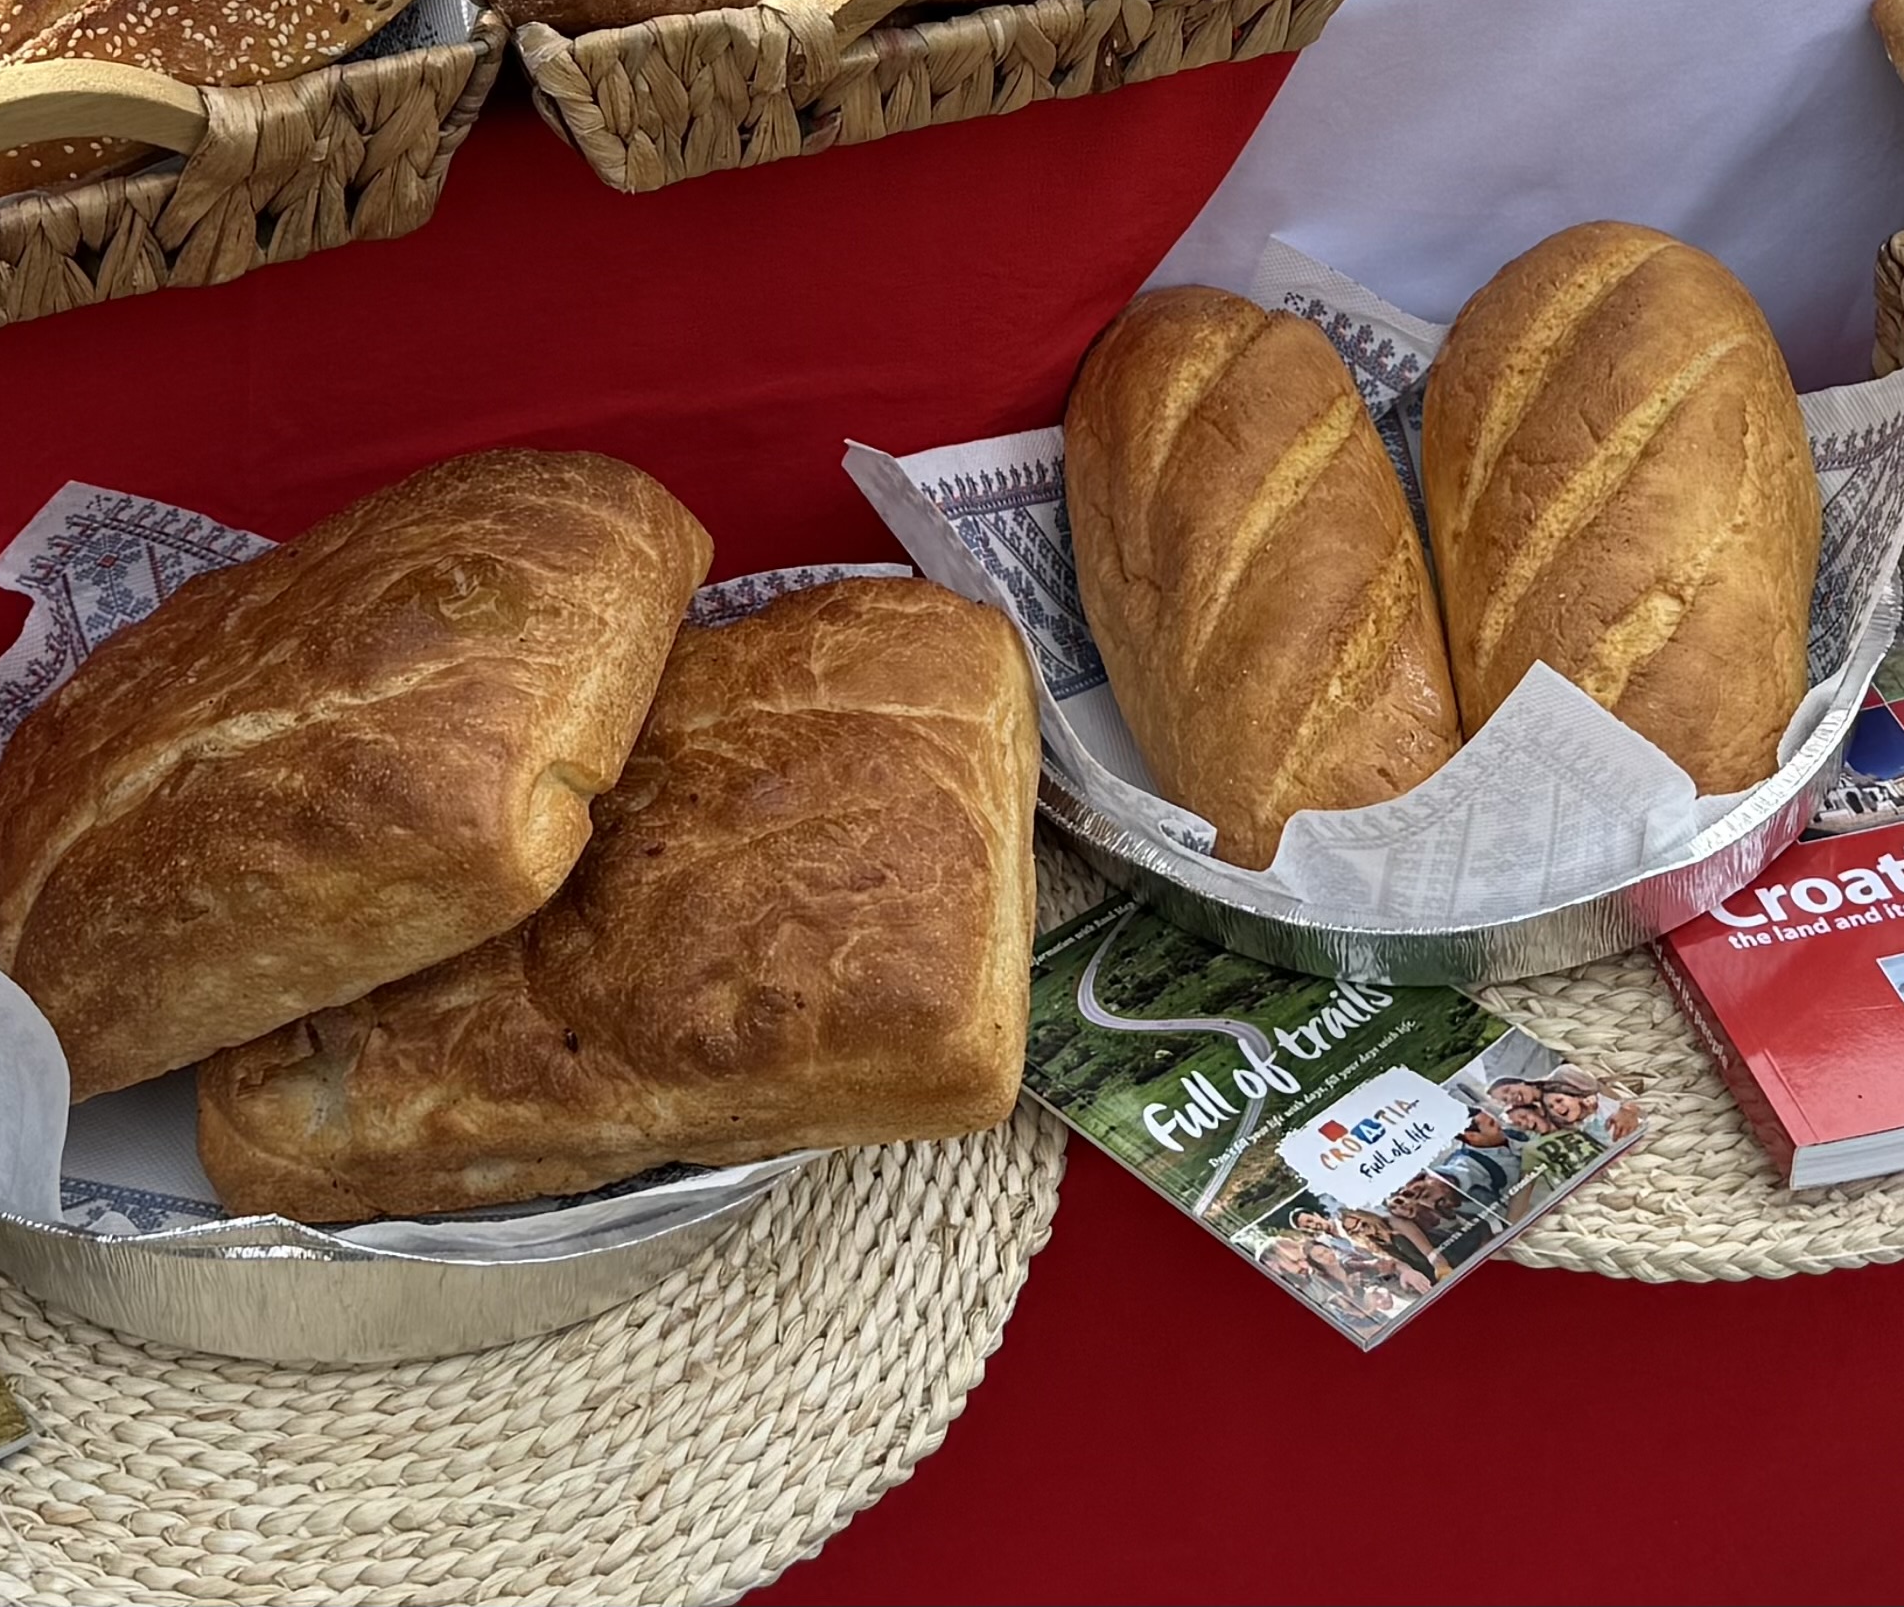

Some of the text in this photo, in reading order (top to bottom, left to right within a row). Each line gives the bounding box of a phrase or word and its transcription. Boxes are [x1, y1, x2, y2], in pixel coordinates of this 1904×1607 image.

[1728, 926, 1773, 951] the
[1775, 916, 1831, 943] land
[1835, 905, 1883, 931] and
[1142, 980, 1394, 1153] Full of trails
[1319, 1097, 1420, 1171] CROATIA
